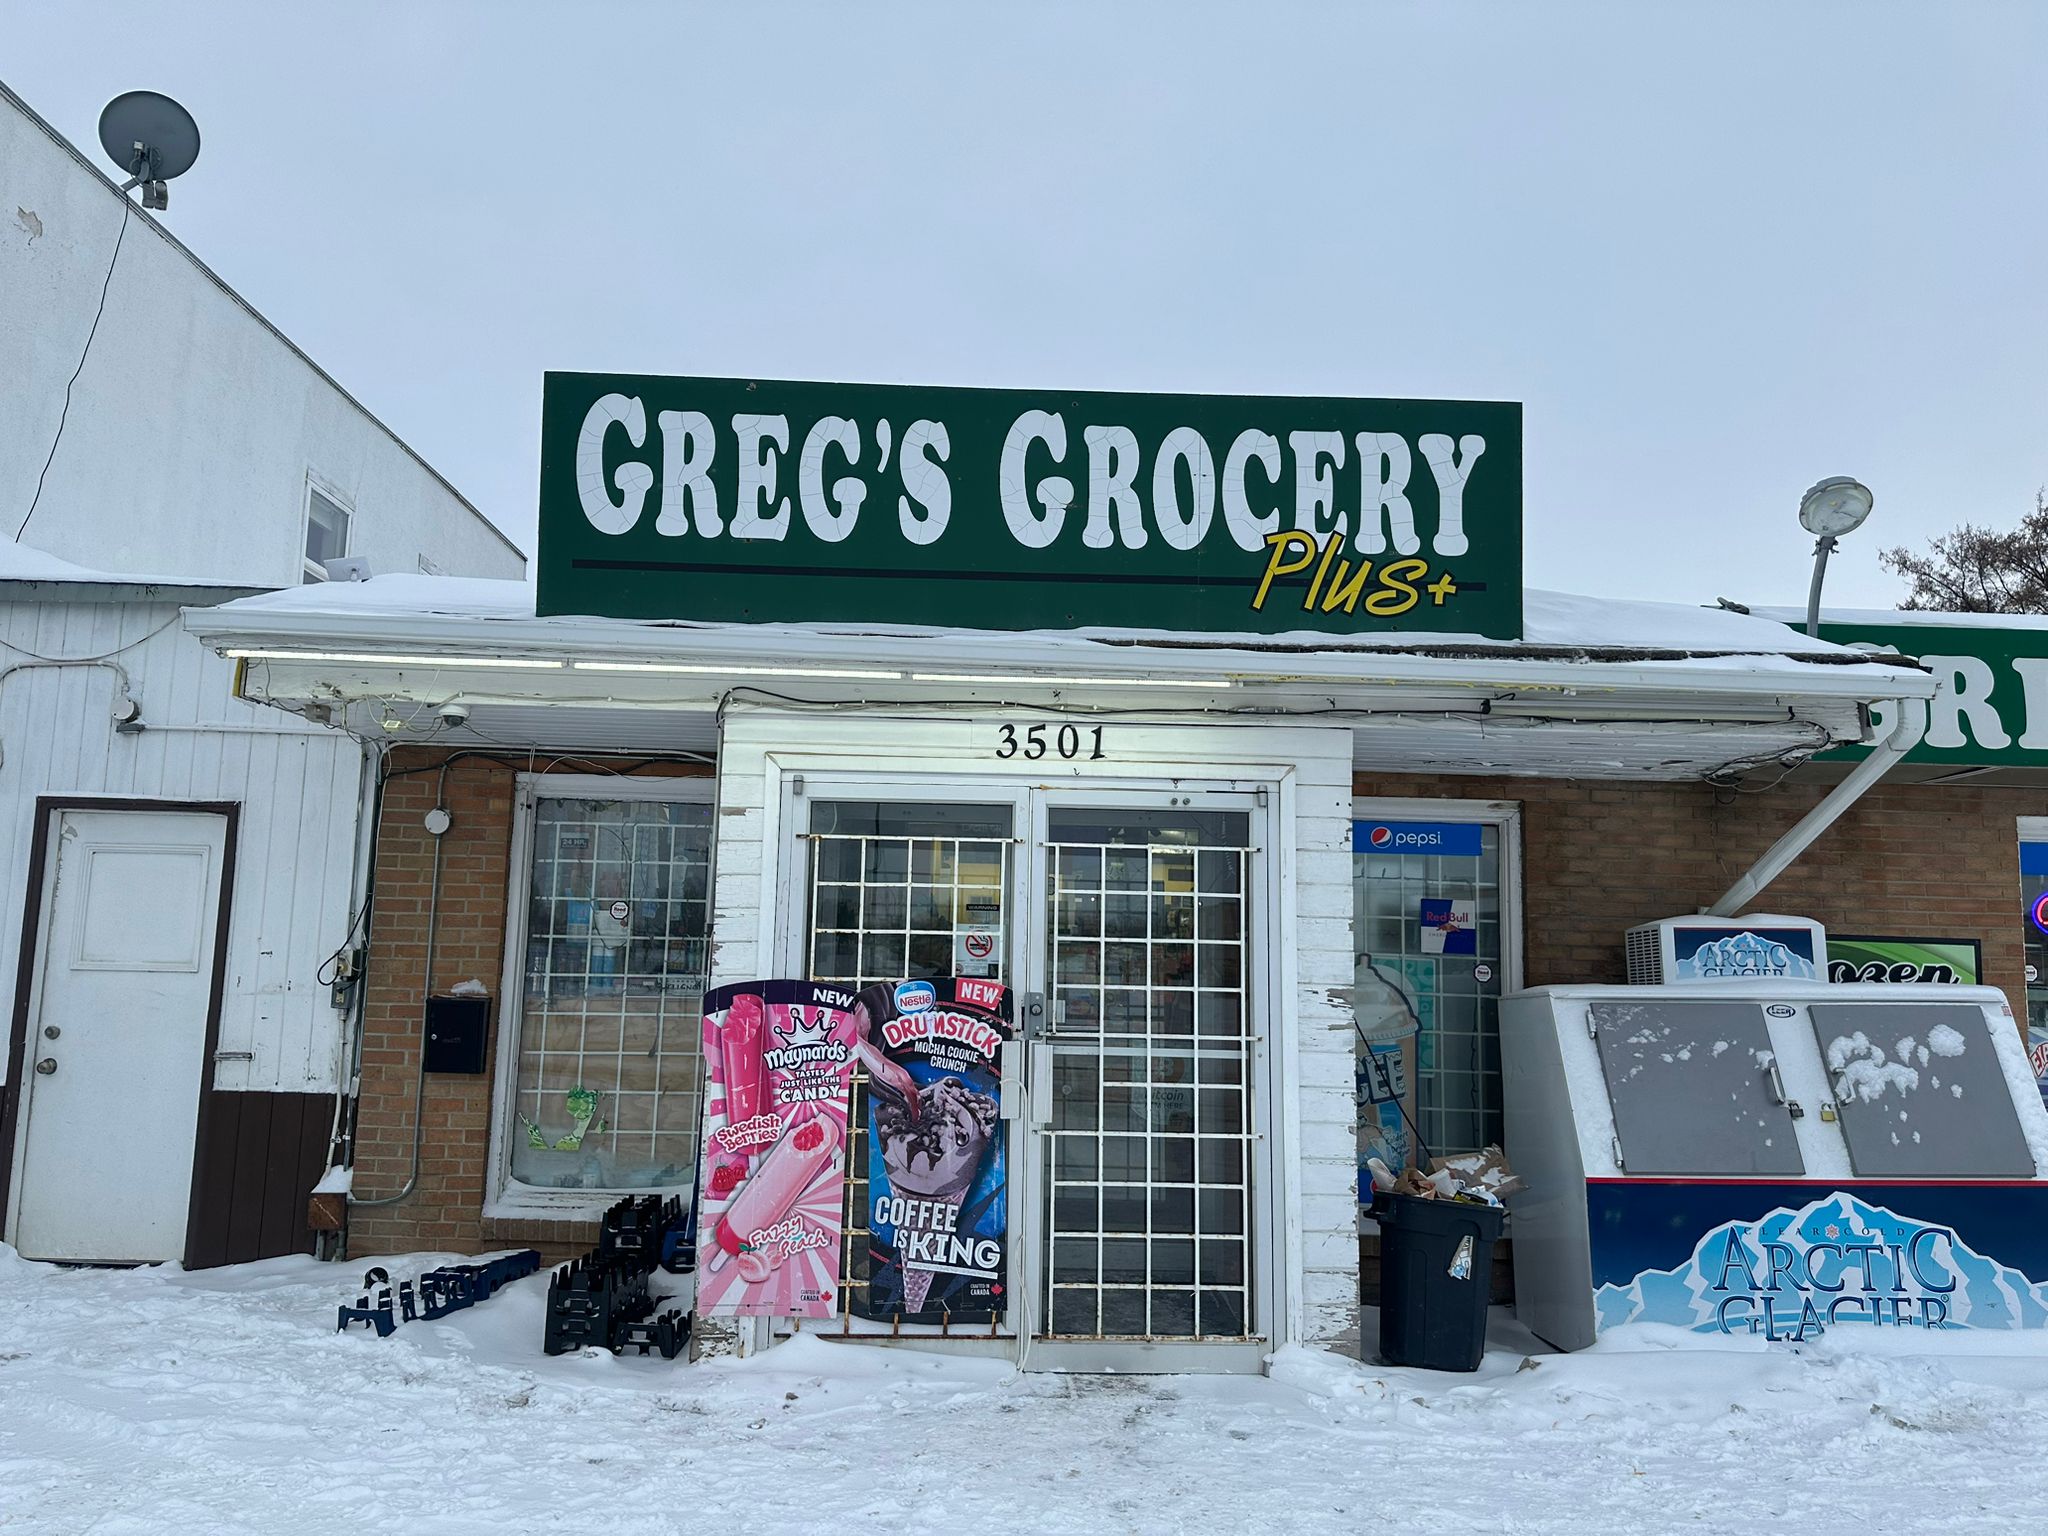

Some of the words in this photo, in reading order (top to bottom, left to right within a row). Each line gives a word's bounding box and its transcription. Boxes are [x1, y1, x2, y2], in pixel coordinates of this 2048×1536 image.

[576, 393, 952, 545] GREG'S
[999, 409, 1486, 557] GROCERY
[996, 723, 1106, 760] 3501
[1395, 831, 1441, 847] pepsi
[1426, 911, 1448, 922] Red
[1449, 912, 1469, 923] Bull
[1702, 944, 1787, 968] ARCTIC
[812, 988, 853, 1007] NEW
[961, 982, 999, 1004] NEW
[914, 1041, 946, 1056] MOCHA
[947, 1045, 980, 1063] COOKIE
[795, 1069, 825, 1078] TASTES
[930, 1055, 967, 1073] CRUNCH
[780, 1079, 800, 1088] JUST
[803, 1077, 822, 1086] LIKE
[824, 1076, 841, 1084] THE
[780, 1085, 841, 1103] CANDY
[1146, 1087, 1185, 1101] itcoin
[717, 1115, 781, 1141] Swedish
[725, 1129, 779, 1151] Berries
[874, 1196, 960, 1233] COFFEE
[750, 1216, 803, 1248] Fuzzy
[1744, 1226, 1820, 1236] CLEAR
[1843, 1226, 1906, 1236] COLD
[892, 1228, 908, 1249] IS
[908, 1230, 1001, 1269] KING
[1712, 1224, 1957, 1293] ARCTIC
[800, 1294, 820, 1302] CANADA
